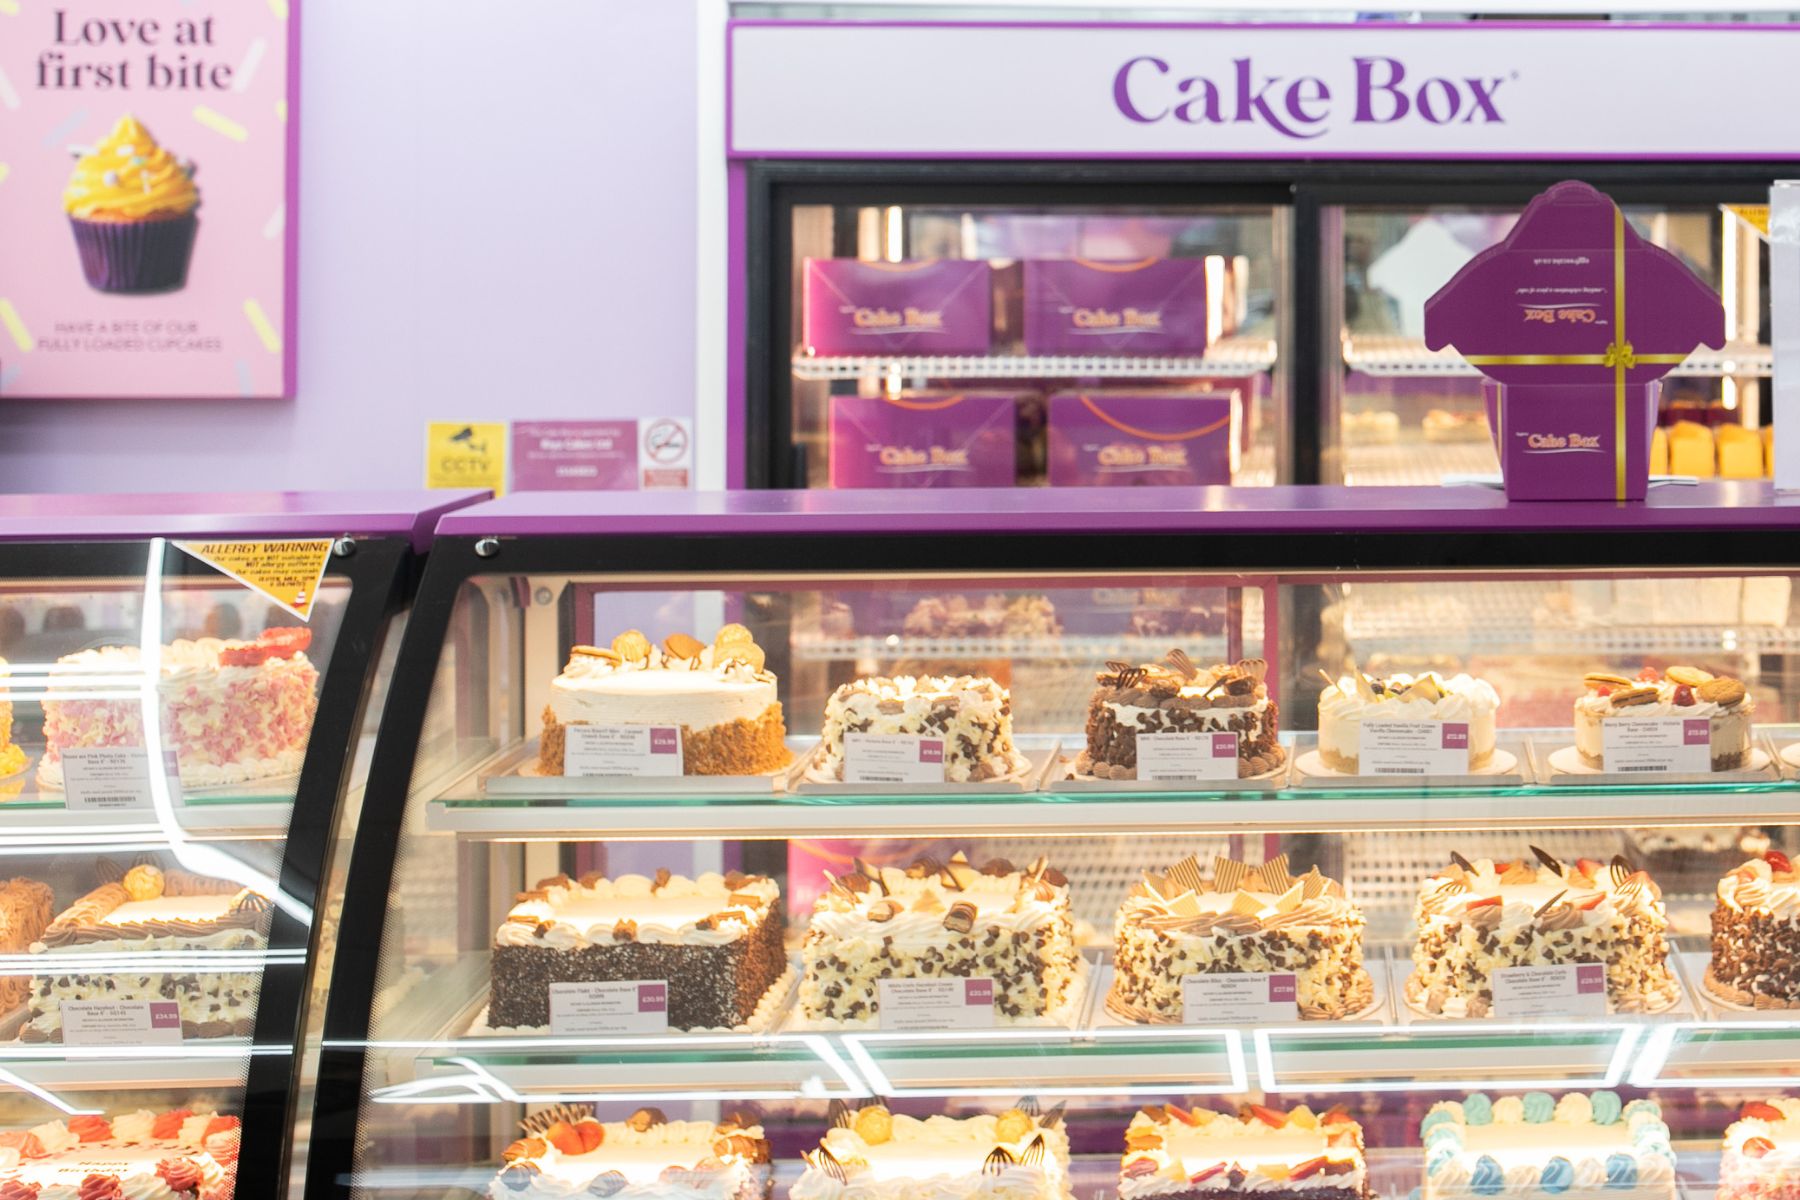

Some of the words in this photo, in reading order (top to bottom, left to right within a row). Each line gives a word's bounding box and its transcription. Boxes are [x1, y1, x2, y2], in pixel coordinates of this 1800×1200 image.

[54, 10, 160, 46] Love
[174, 15, 216, 46] at
[36, 51, 132, 90] first
[147, 53, 233, 91] bite
[1112, 55, 1331, 139] Cake
[1352, 56, 1506, 125] Box
[853, 307, 901, 328] Cake
[904, 307, 942, 328] Box
[1073, 307, 1120, 328] Cake
[1123, 307, 1161, 328] Box
[1523, 309, 1556, 324] Box
[1556, 309, 1596, 324] Cake
[38, 337, 80, 352] FULLY
[83, 337, 145, 352] LOADED
[148, 337, 222, 352] CUPCAKES
[1527, 433, 1567, 448] Cake
[1568, 433, 1601, 448] Box
[879, 447, 926, 466] Cake
[930, 447, 969, 466] Box
[1098, 446, 1146, 466] Cake
[1149, 446, 1188, 466] Box
[440, 458, 491, 474] CCTV
[201, 543, 257, 554] ALLERGY
[263, 542, 328, 553] WARNING
